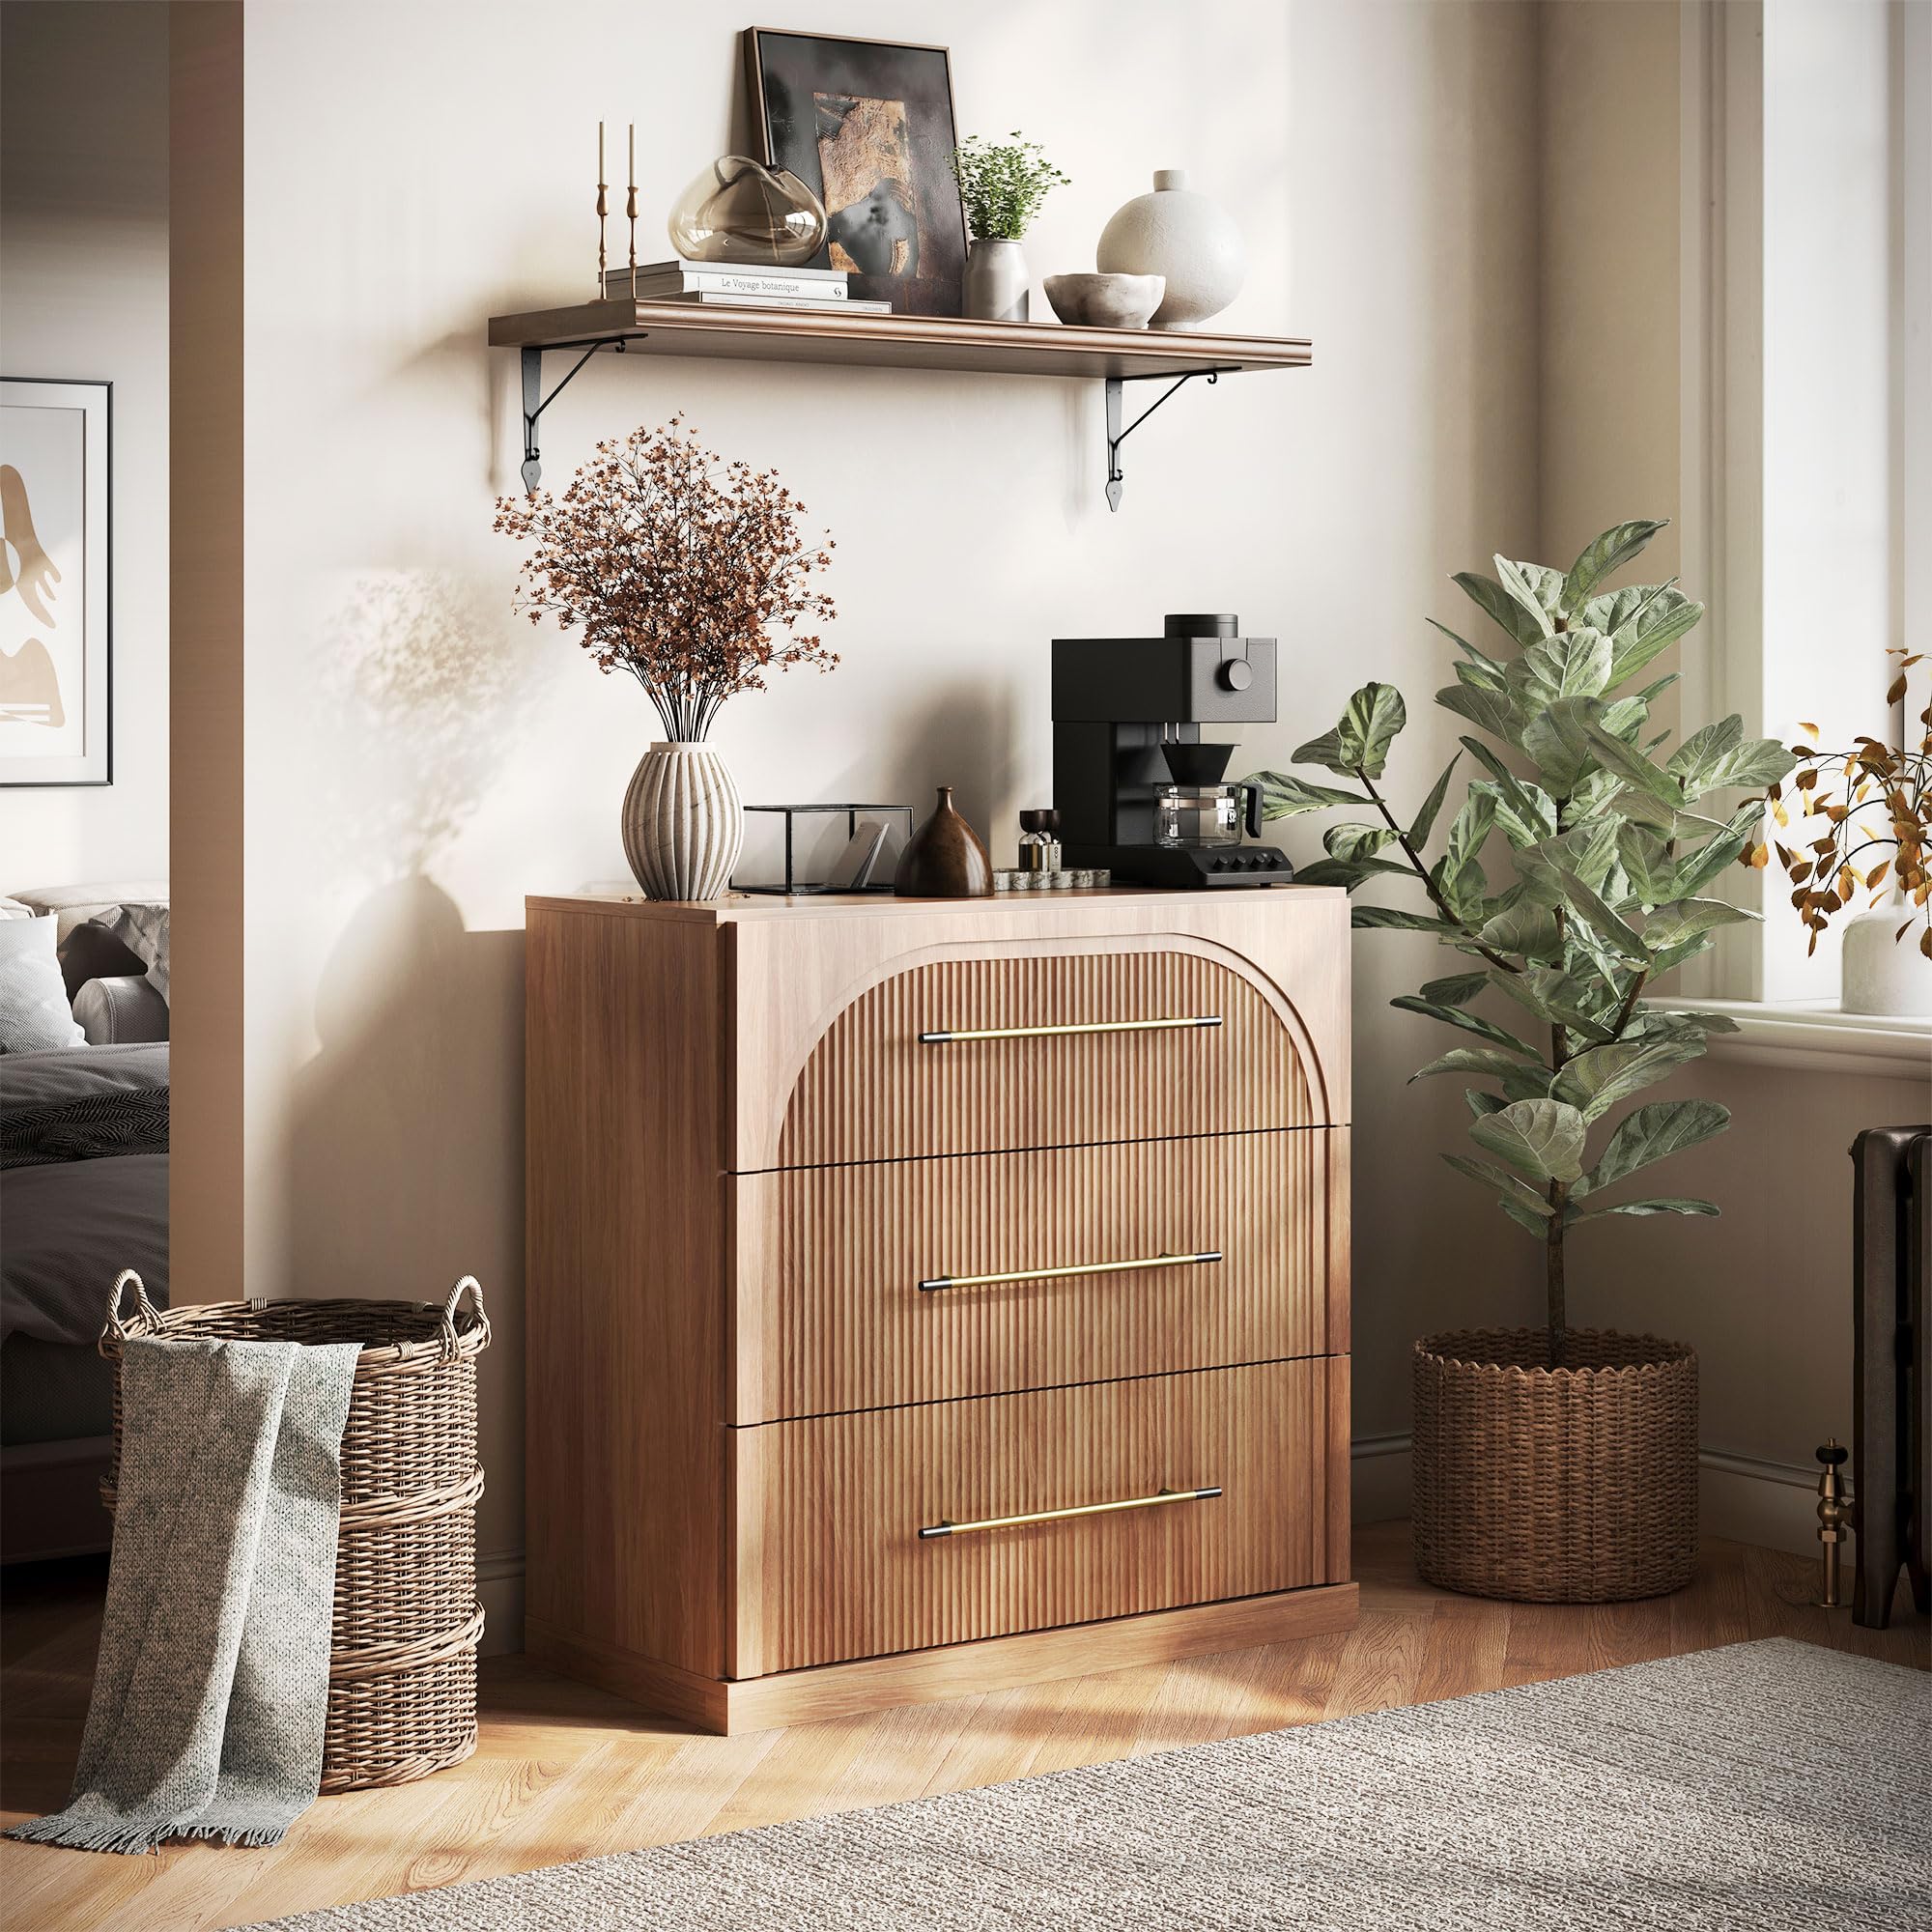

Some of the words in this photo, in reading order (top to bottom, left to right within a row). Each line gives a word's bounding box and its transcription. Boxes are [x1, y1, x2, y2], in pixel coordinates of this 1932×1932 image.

[722, 278, 731, 288] Le
[732, 279, 760, 291] Voyage
[761, 280, 800, 293] botanique
